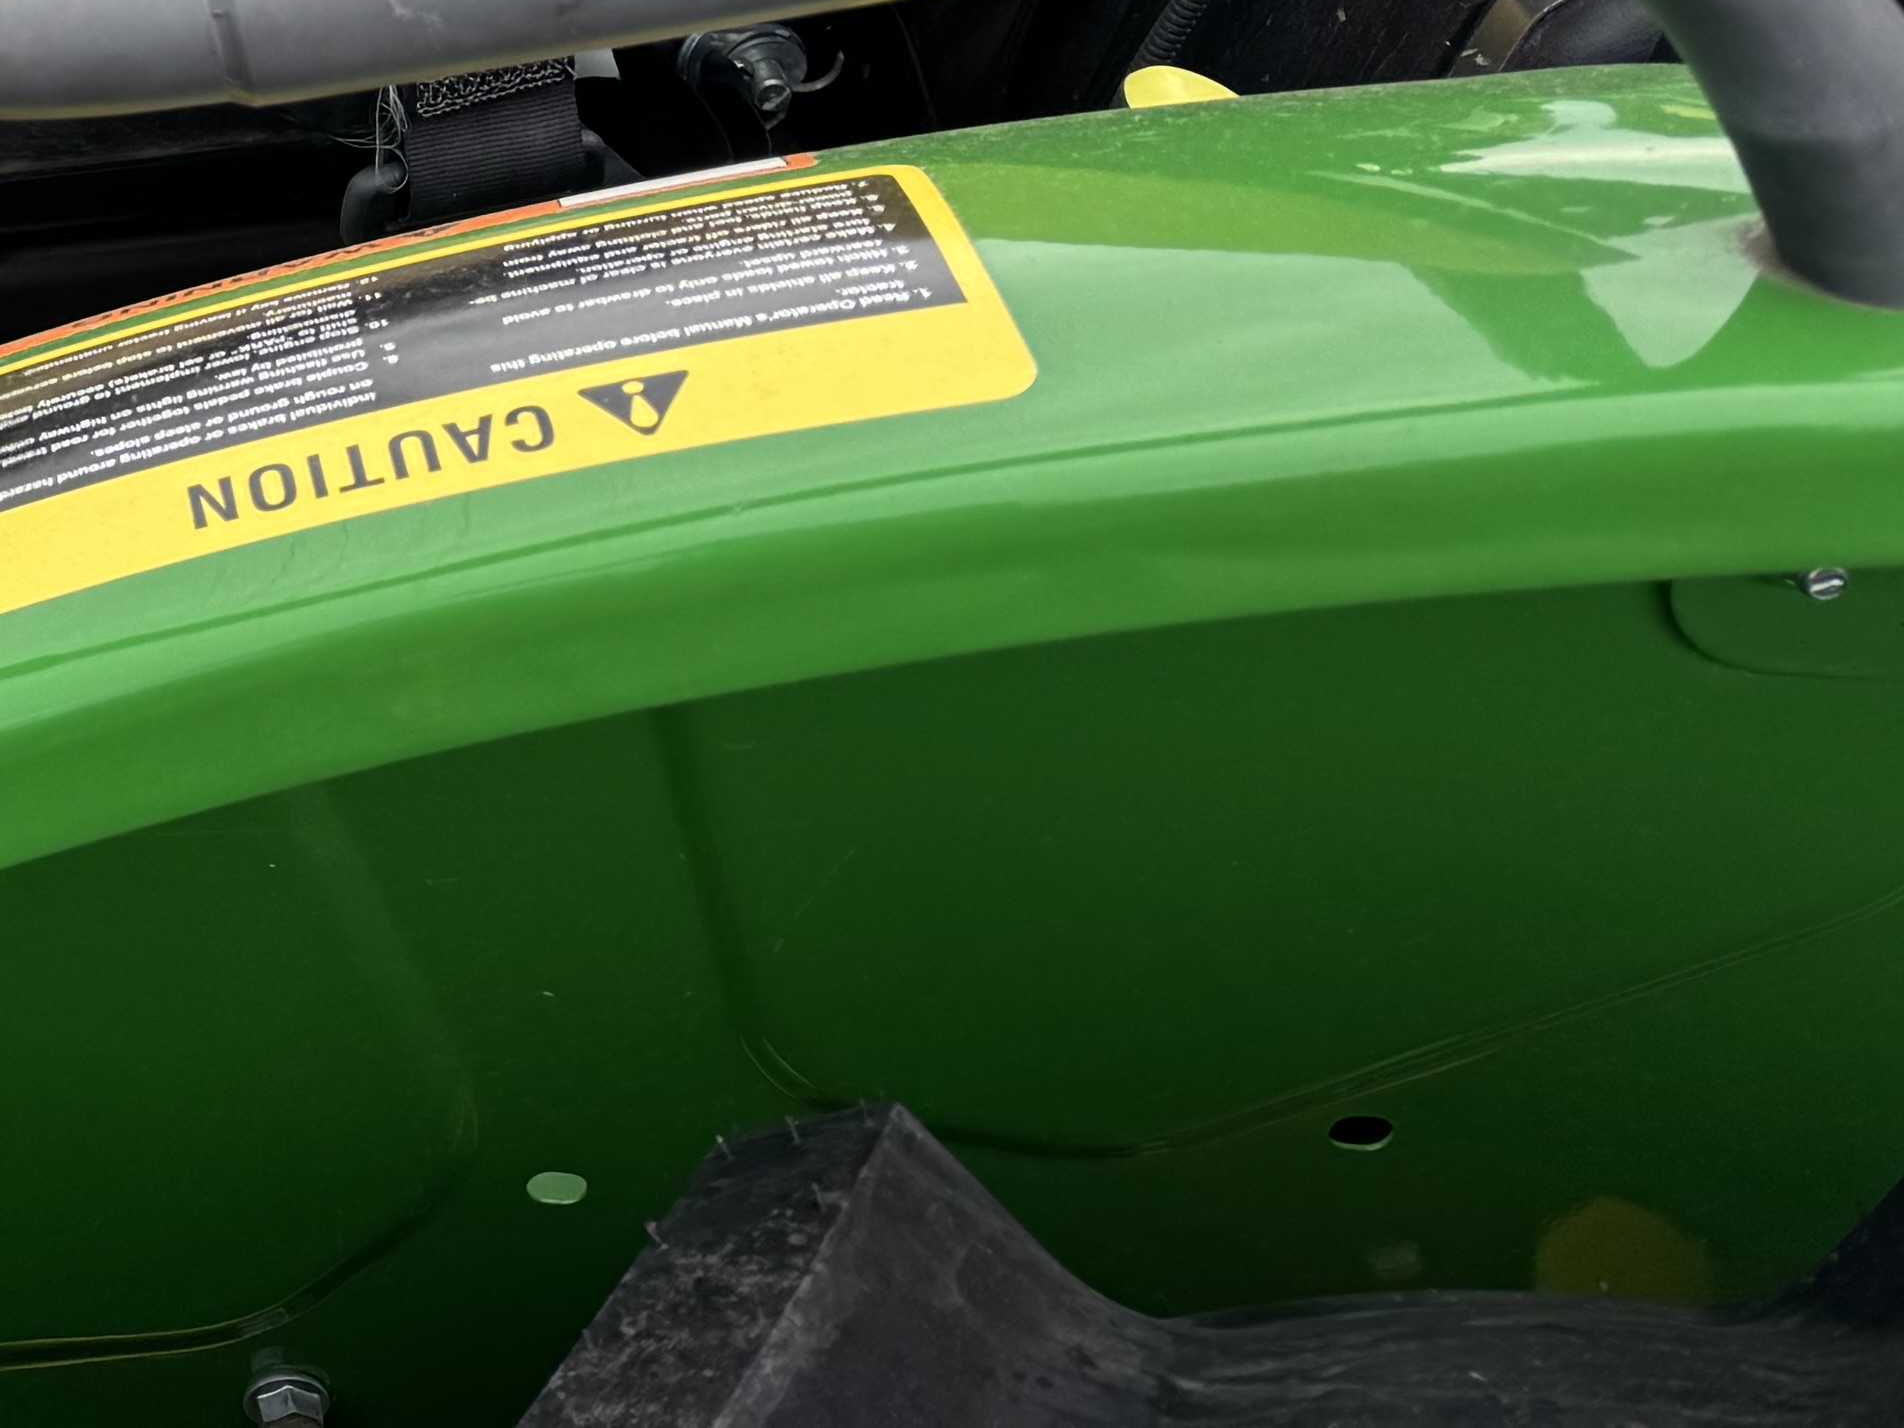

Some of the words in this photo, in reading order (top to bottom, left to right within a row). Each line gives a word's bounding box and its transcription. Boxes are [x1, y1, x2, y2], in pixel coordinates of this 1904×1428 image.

[837, 248, 887, 262] Hitch
[721, 266, 772, 280] loads
[776, 257, 833, 273] towed
[845, 263, 895, 276] Keep
[678, 276, 717, 289] only
[747, 276, 815, 293] shields
[818, 271, 841, 283] all
[654, 283, 674, 292] to
[724, 287, 743, 296] in
[578, 288, 651, 308] drawbar
[858, 291, 909, 306] Read
[554, 303, 574, 312] to
[502, 307, 550, 325] avoid
[683, 315, 752, 336] Manual
[528, 340, 616, 364] operating
[489, 358, 525, 372] this
[348, 378, 373, 390] on
[293, 385, 345, 403] rough
[227, 397, 289, 422] ground
[289, 391, 375, 420] individual
[205, 415, 224, 426] or
[227, 413, 286, 434] brakes
[154, 421, 201, 440] steep
[204, 429, 224, 440] or
[119, 435, 201, 463] operating
[56, 458, 116, 483] around
[186, 405, 556, 530] CAUTION
